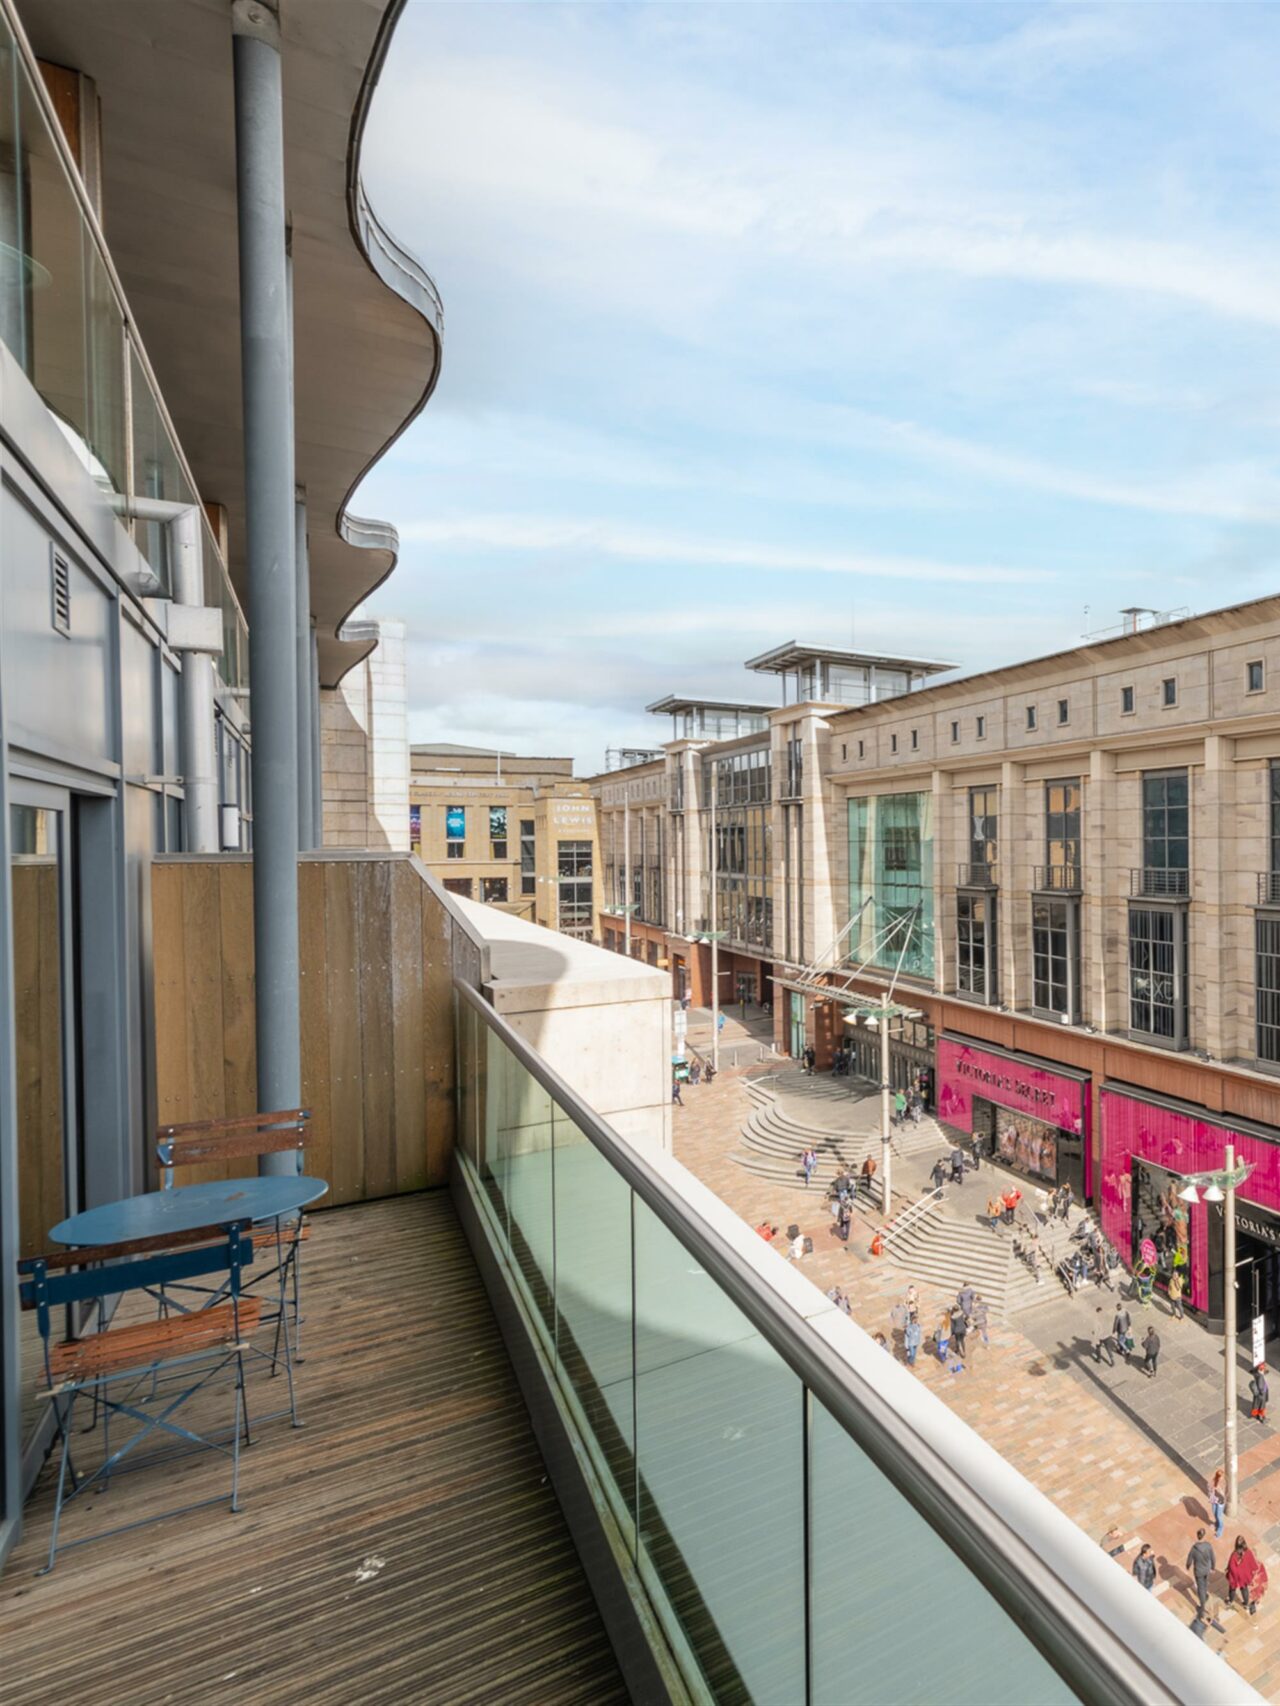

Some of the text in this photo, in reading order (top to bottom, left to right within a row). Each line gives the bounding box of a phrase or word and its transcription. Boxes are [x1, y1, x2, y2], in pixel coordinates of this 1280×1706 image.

[556, 803, 591, 812] JOHN
[553, 816, 593, 825] LEWIS
[1215, 1204, 1276, 1241] VTORIA'S
